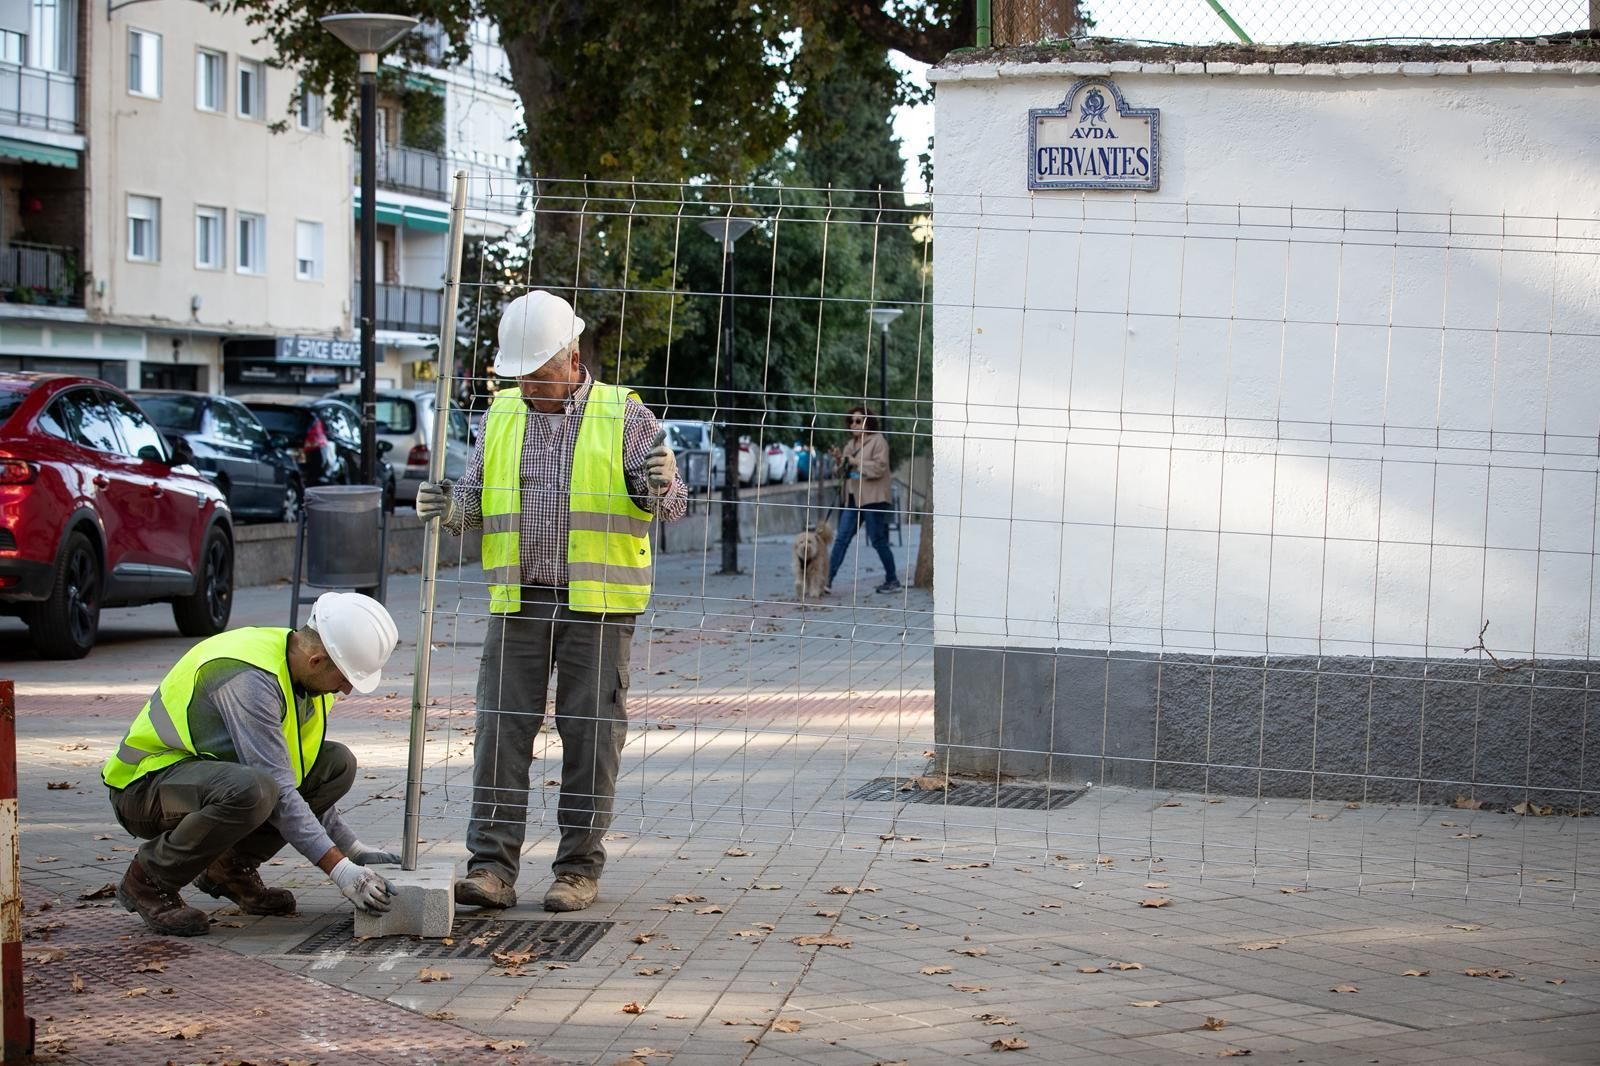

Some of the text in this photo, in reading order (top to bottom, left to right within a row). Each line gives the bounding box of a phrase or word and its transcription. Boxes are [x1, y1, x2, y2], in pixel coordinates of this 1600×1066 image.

[1037, 146, 1149, 176] CERVANTES
[297, 339, 361, 361] SPACE ESCAP
